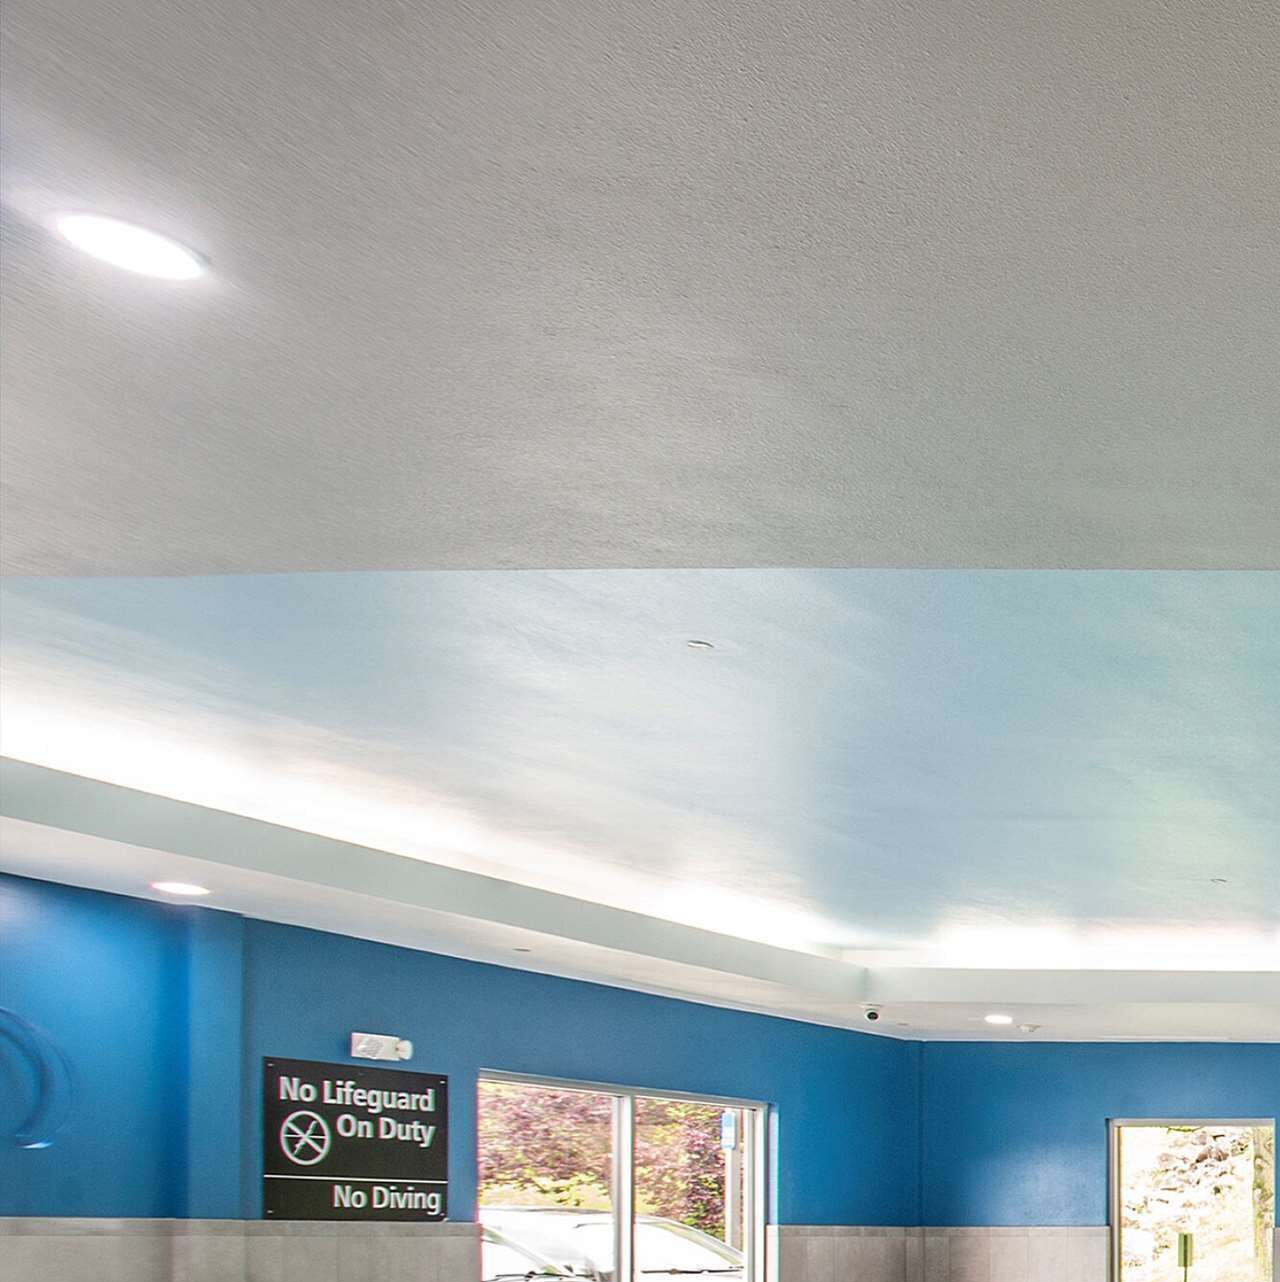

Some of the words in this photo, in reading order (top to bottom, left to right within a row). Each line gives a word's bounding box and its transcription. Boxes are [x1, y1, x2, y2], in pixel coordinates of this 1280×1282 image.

[279, 1076, 316, 1102] No
[323, 1080, 435, 1113] Lifeguard
[337, 1114, 373, 1139] On
[379, 1118, 436, 1147] Duty
[333, 1185, 367, 1209] No
[372, 1186, 441, 1215] Diving
